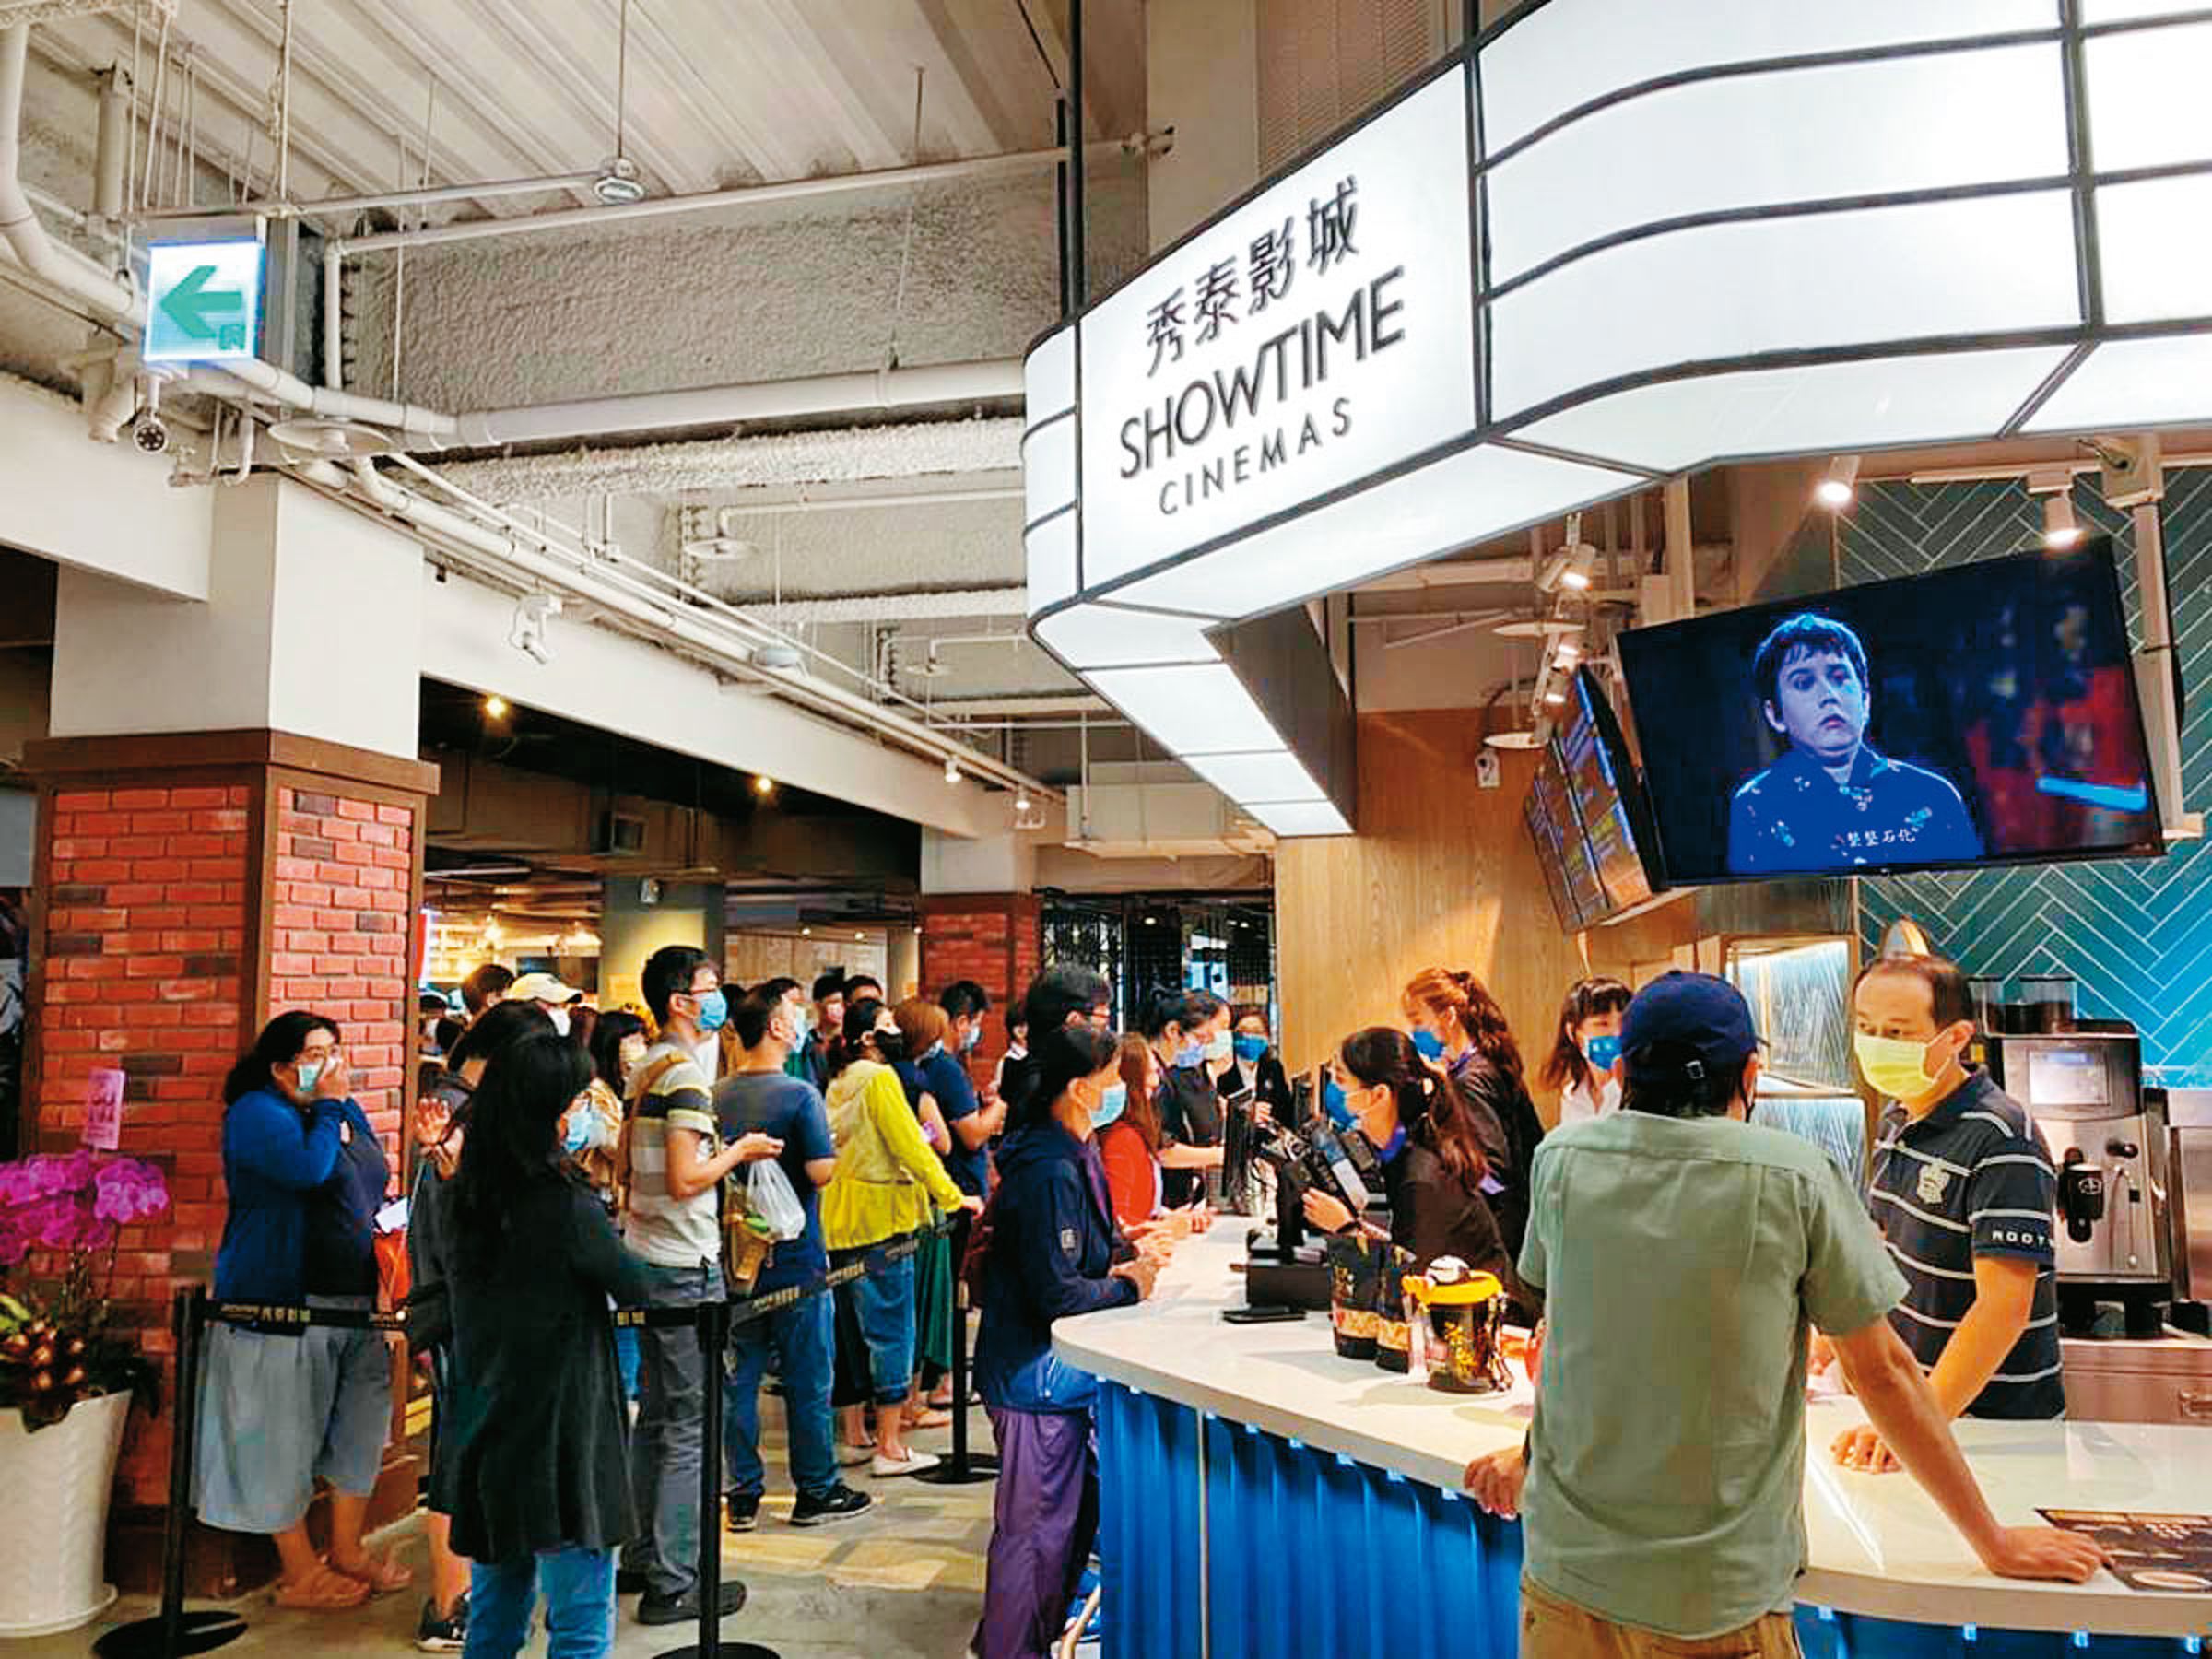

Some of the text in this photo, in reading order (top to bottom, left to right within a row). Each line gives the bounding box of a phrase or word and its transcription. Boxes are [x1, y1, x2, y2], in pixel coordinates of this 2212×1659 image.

[1120, 265, 1406, 479] SHOWTIME
[1146, 175, 1360, 378] 秀泰影城
[1159, 397, 1352, 515] CINEMAS
